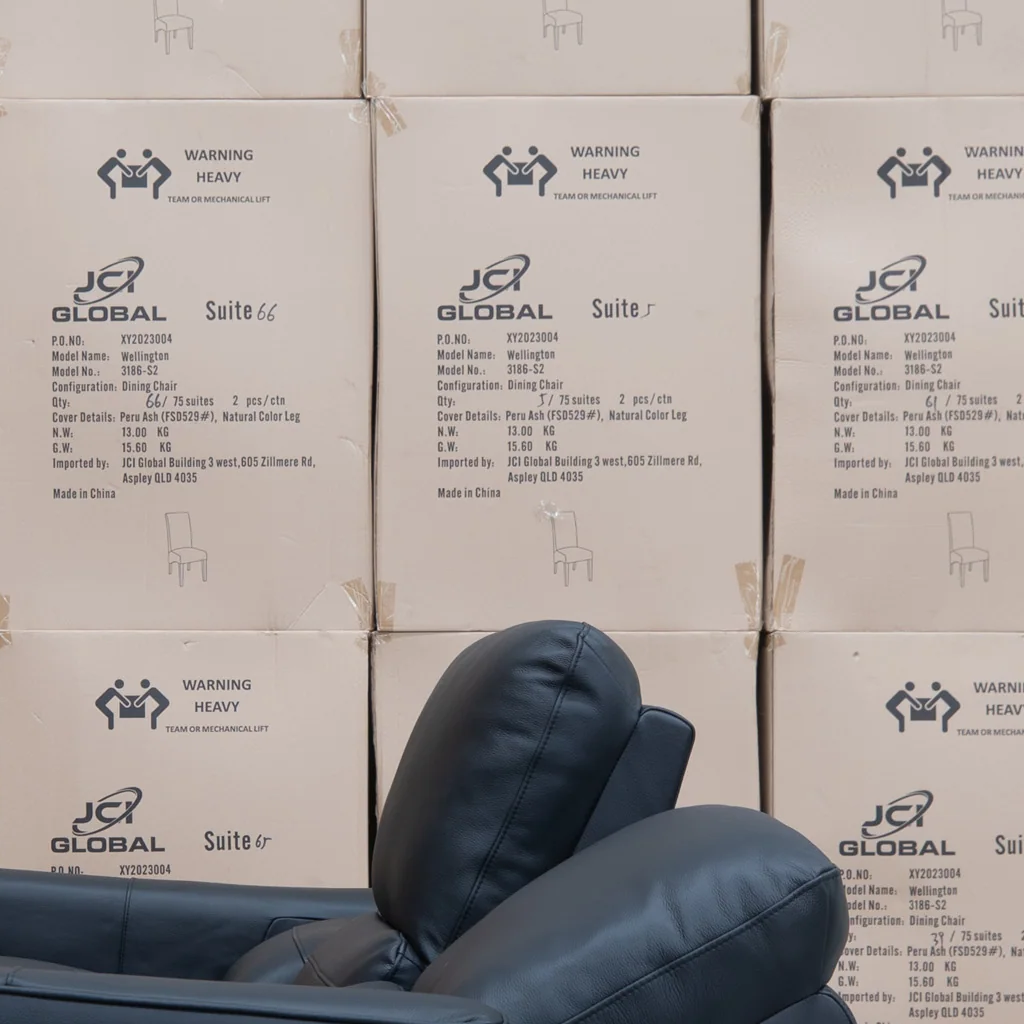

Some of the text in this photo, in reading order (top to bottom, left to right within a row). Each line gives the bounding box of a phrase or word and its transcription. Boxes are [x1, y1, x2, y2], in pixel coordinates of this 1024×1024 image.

[185, 149, 253, 160] WARNING
[571, 146, 639, 157] WARNING
[964, 146, 1024, 158] WARNIN
[197, 172, 241, 183] HEAVY
[583, 168, 627, 179] HEAVY
[977, 168, 1022, 180] HEAVY
[206, 300, 277, 321] Suite 66
[437, 304, 553, 321] GLOBAL
[592, 298, 639, 318] Suite
[833, 304, 950, 322] GLOBAL
[52, 306, 167, 322] GLOBAL
[904, 332, 956, 343] XY2023004
[834, 349, 952, 362] Model Name: Wellington
[508, 426, 532, 436] 13.00
[543, 425, 555, 436] KG
[508, 441, 532, 452] 15.60
[546, 441, 557, 451] KG
[53, 458, 93, 470] Imported
[96, 458, 109, 470] by:
[122, 457, 135, 468] JCI
[138, 457, 166, 468] Global
[169, 457, 206, 470] Building
[208, 457, 213, 467] 3
[261, 456, 298, 467] Zillmere
[123, 472, 197, 485] Aspley QLD 4035
[438, 487, 500, 498] Made in China
[183, 679, 251, 690] WARNING
[973, 682, 1024, 693] WARNI
[195, 701, 239, 712] HEAVY
[986, 704, 1024, 715] HEAV
[51, 836, 165, 853] GLOBAL
[205, 831, 251, 851] Suite
[839, 839, 956, 856] GLOBAL
[909, 868, 961, 879] XY2023004
[909, 961, 934, 972] 13.00
[945, 961, 956, 972] KG
[909, 976, 934, 987] 15.60
[947, 976, 959, 987] KG
